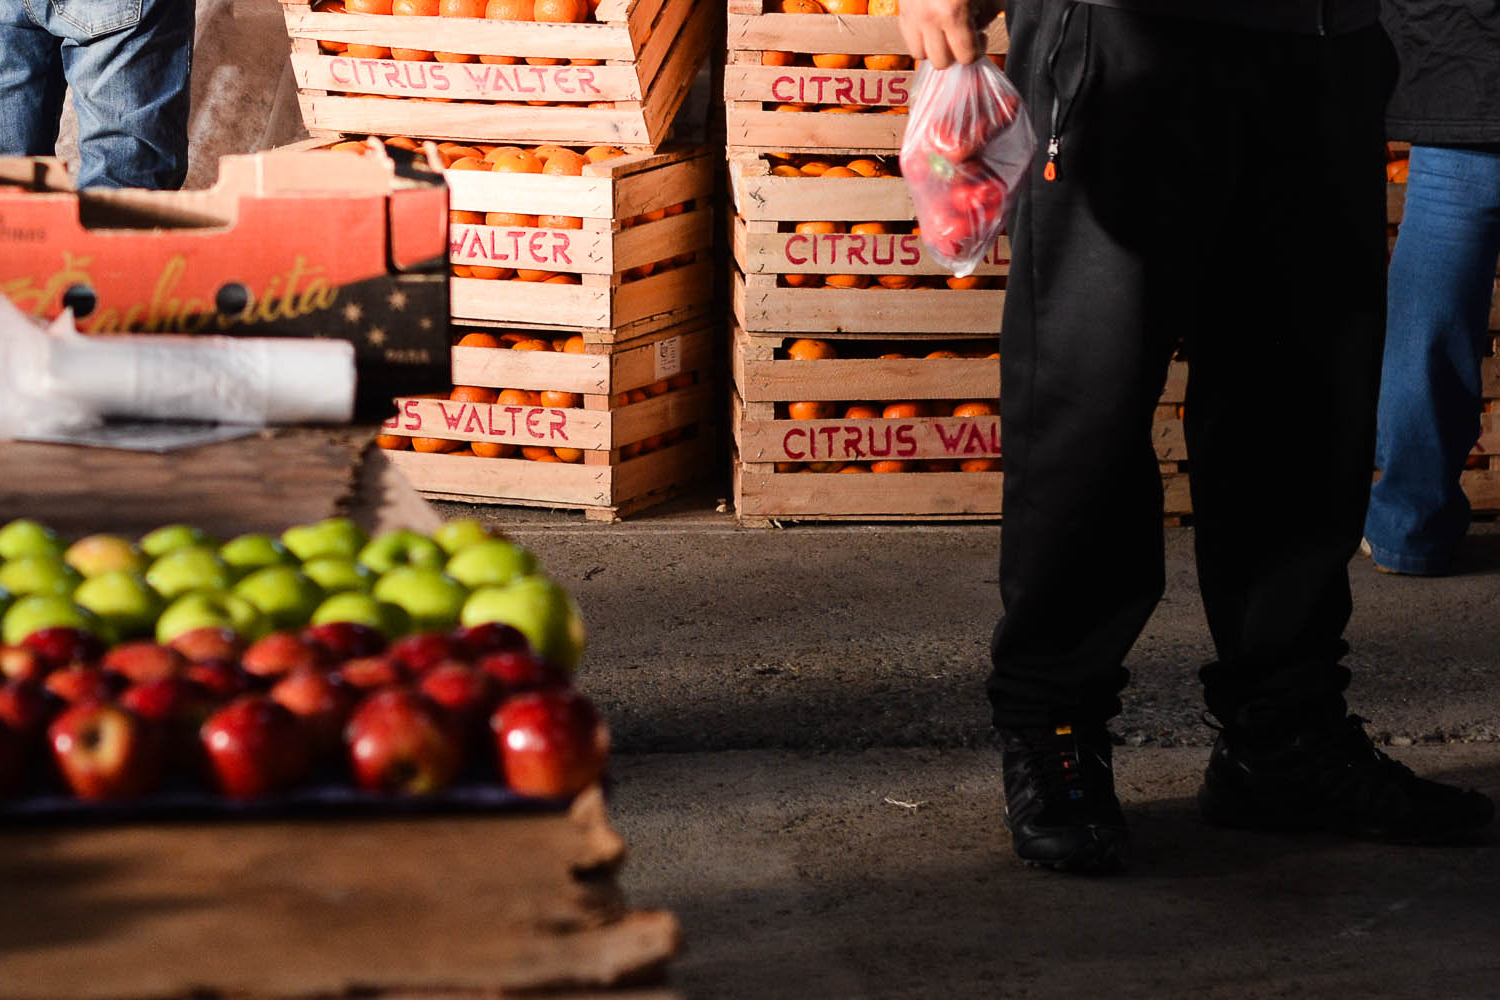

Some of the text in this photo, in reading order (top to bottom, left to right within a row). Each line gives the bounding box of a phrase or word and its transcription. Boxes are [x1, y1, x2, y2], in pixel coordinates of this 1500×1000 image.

[328, 58, 601, 94] CITRUS WALTER
[772, 76, 909, 104] CITRUS
[785, 234, 921, 266] CITRUS
[437, 402, 570, 441] WALTER
[783, 422, 1002, 460] CITRUS WAL
